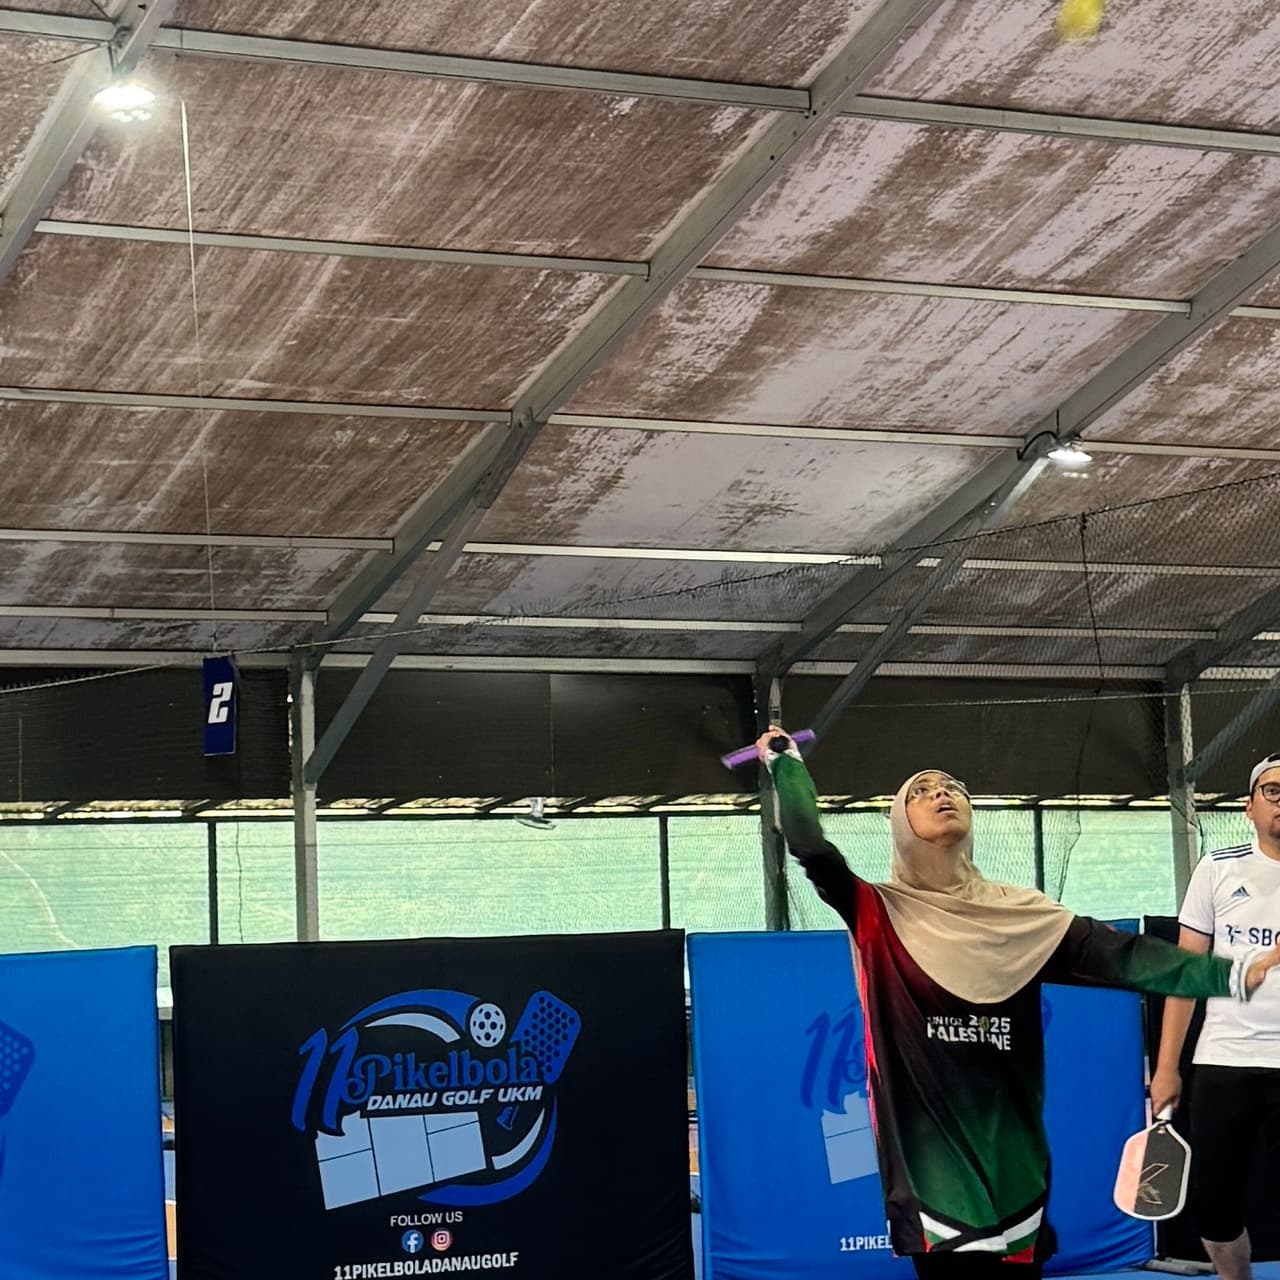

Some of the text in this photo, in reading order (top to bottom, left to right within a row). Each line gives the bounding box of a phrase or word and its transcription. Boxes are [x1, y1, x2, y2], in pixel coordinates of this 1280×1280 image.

[208, 682, 233, 724] 2
[968, 1014, 1011, 1033] 2025
[366, 1085, 544, 1111] DANAU GOLF UKM
[390, 1211, 463, 1227] FOLLOW US
[333, 1252, 520, 1280] 11PIKELBOLADANAUGOLF
